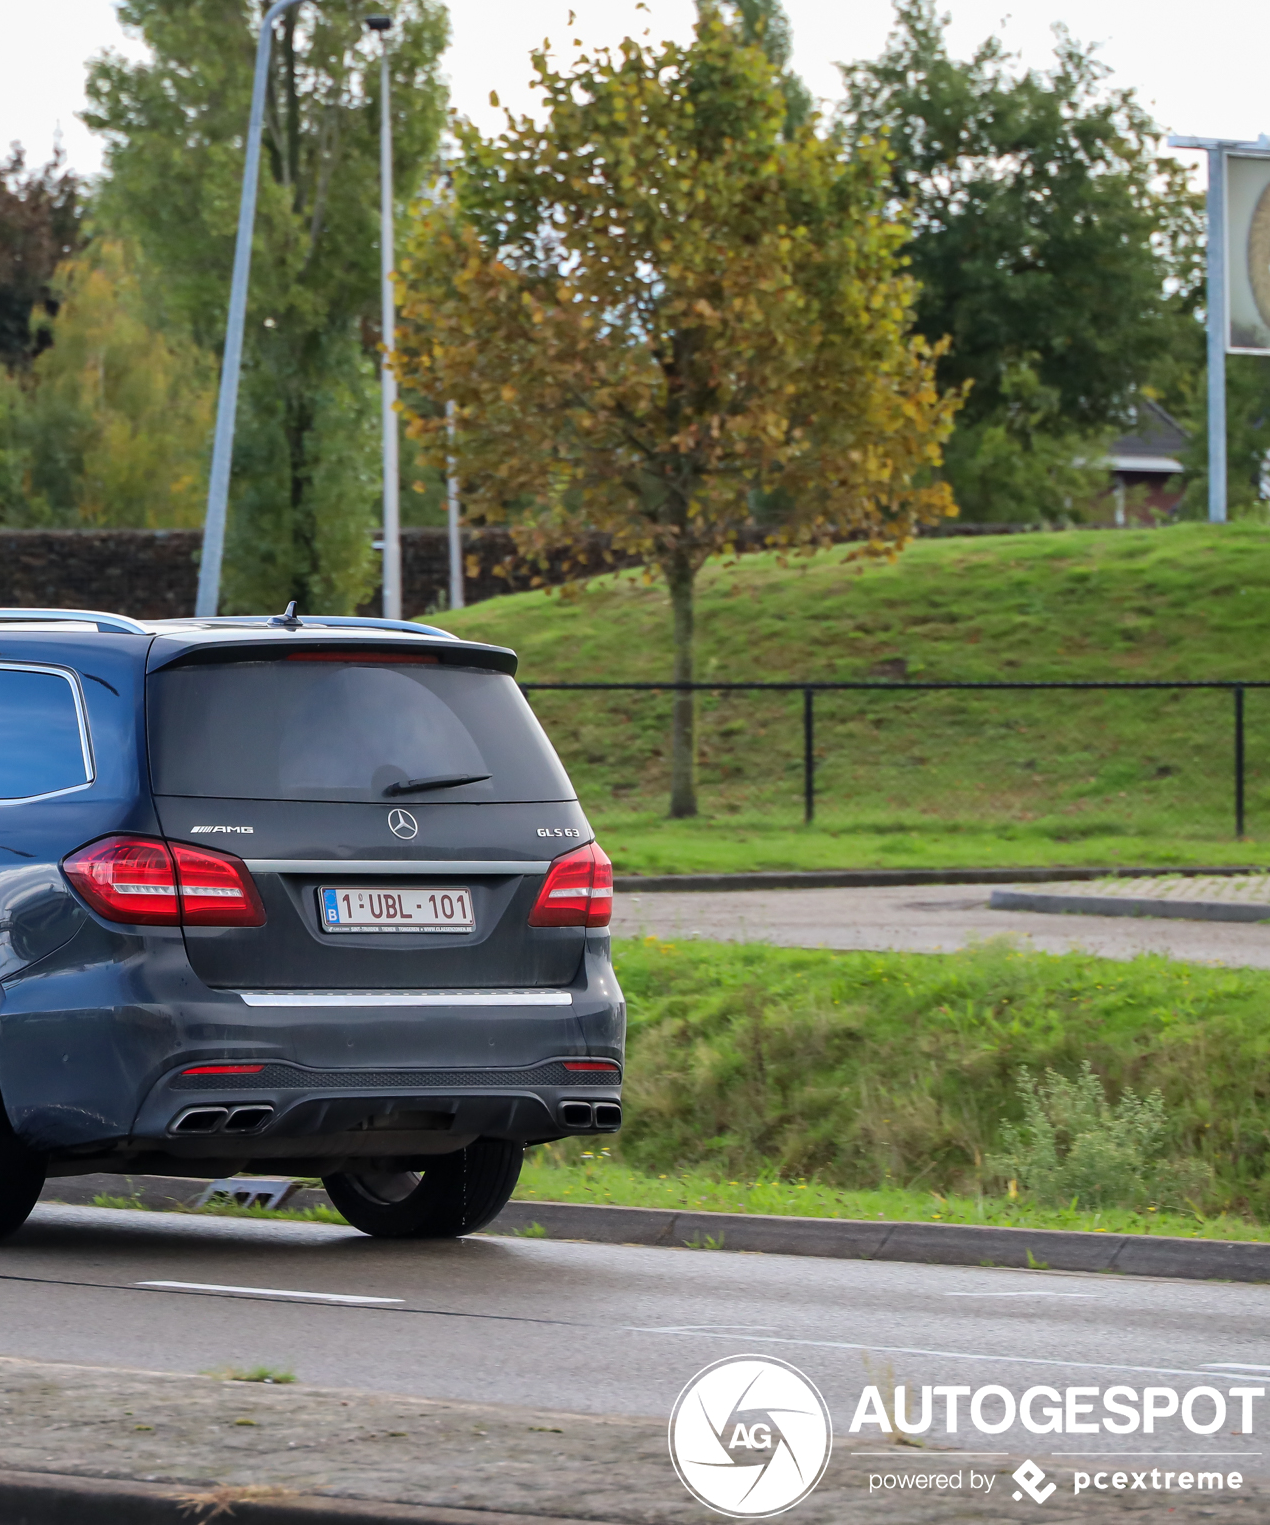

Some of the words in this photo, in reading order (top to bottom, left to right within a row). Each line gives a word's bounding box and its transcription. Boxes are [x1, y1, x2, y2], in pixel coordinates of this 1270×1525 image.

[202, 825, 254, 834] AMG
[536, 828, 563, 837] GLS
[564, 828, 580, 838] 63
[328, 909, 338, 921] B
